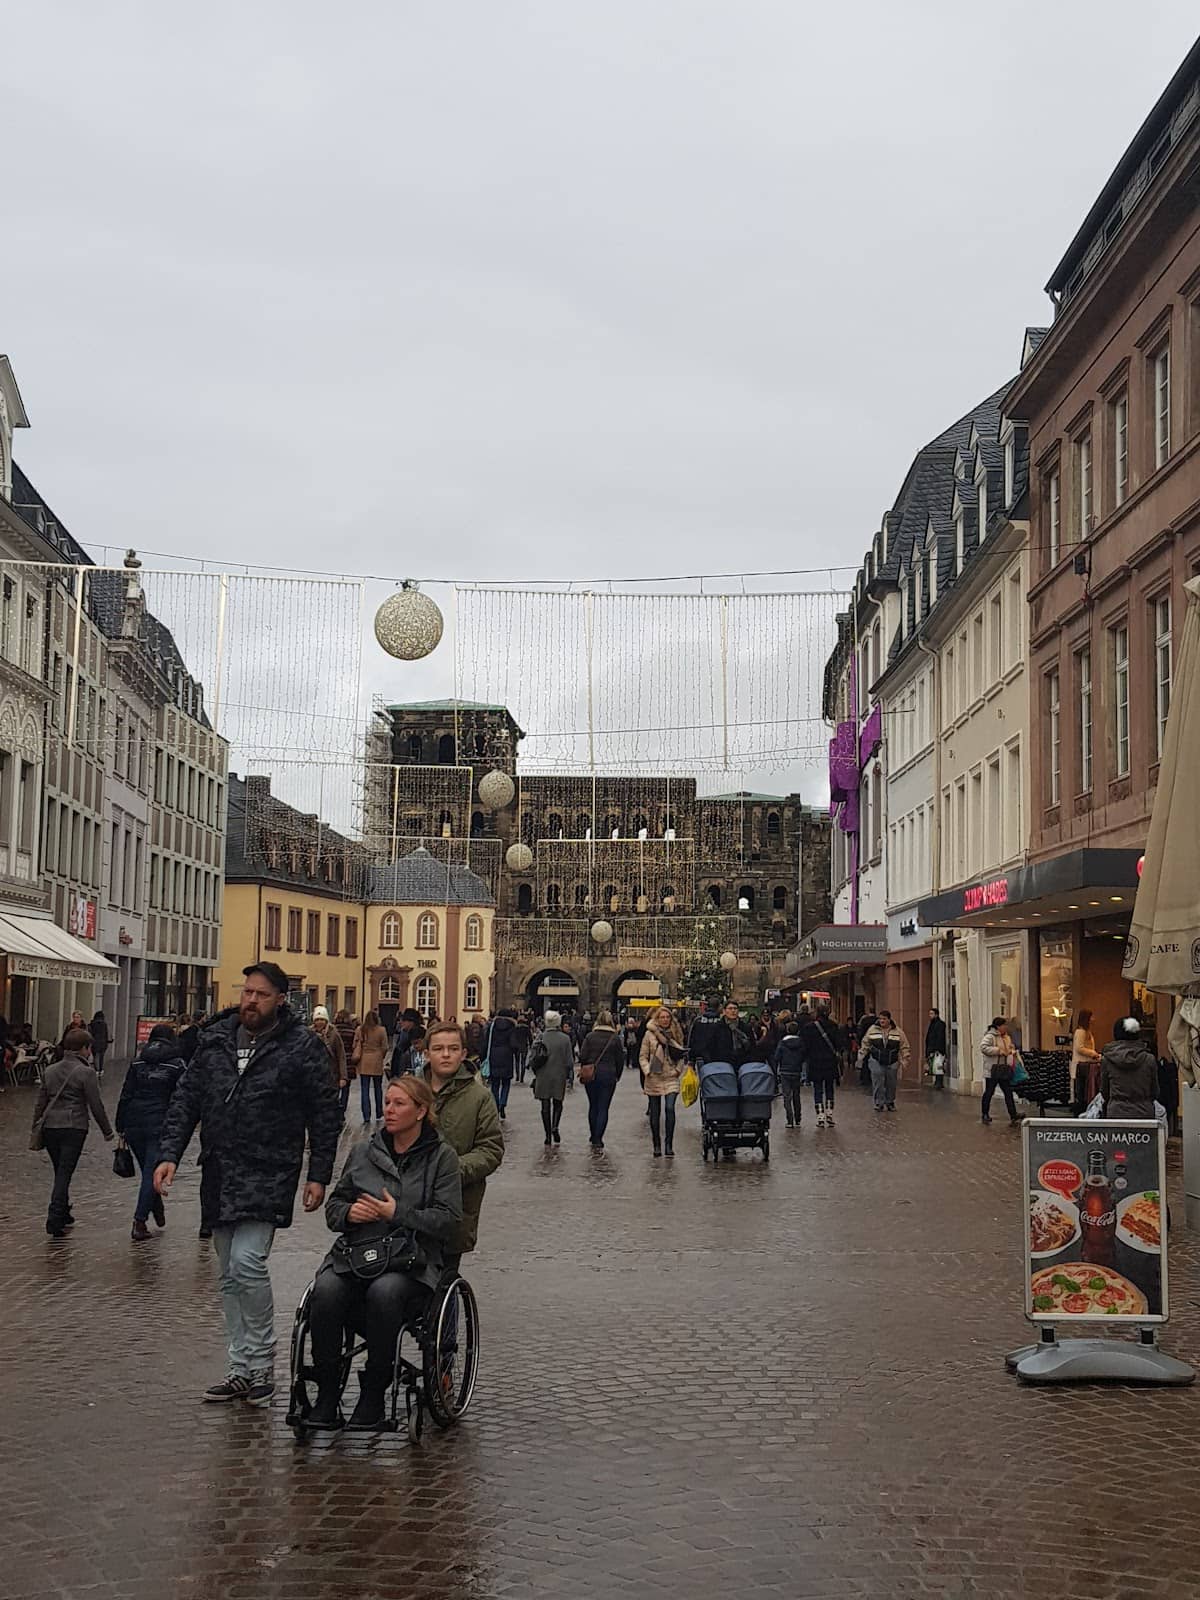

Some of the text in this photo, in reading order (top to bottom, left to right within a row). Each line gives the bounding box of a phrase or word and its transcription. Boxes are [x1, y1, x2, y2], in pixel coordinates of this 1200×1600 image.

[821, 940, 885, 949] HOCHSTETTER
[416, 959, 438, 969] THEO
[1036, 1131, 1150, 1145] PIZZERIA SAN MARCO
